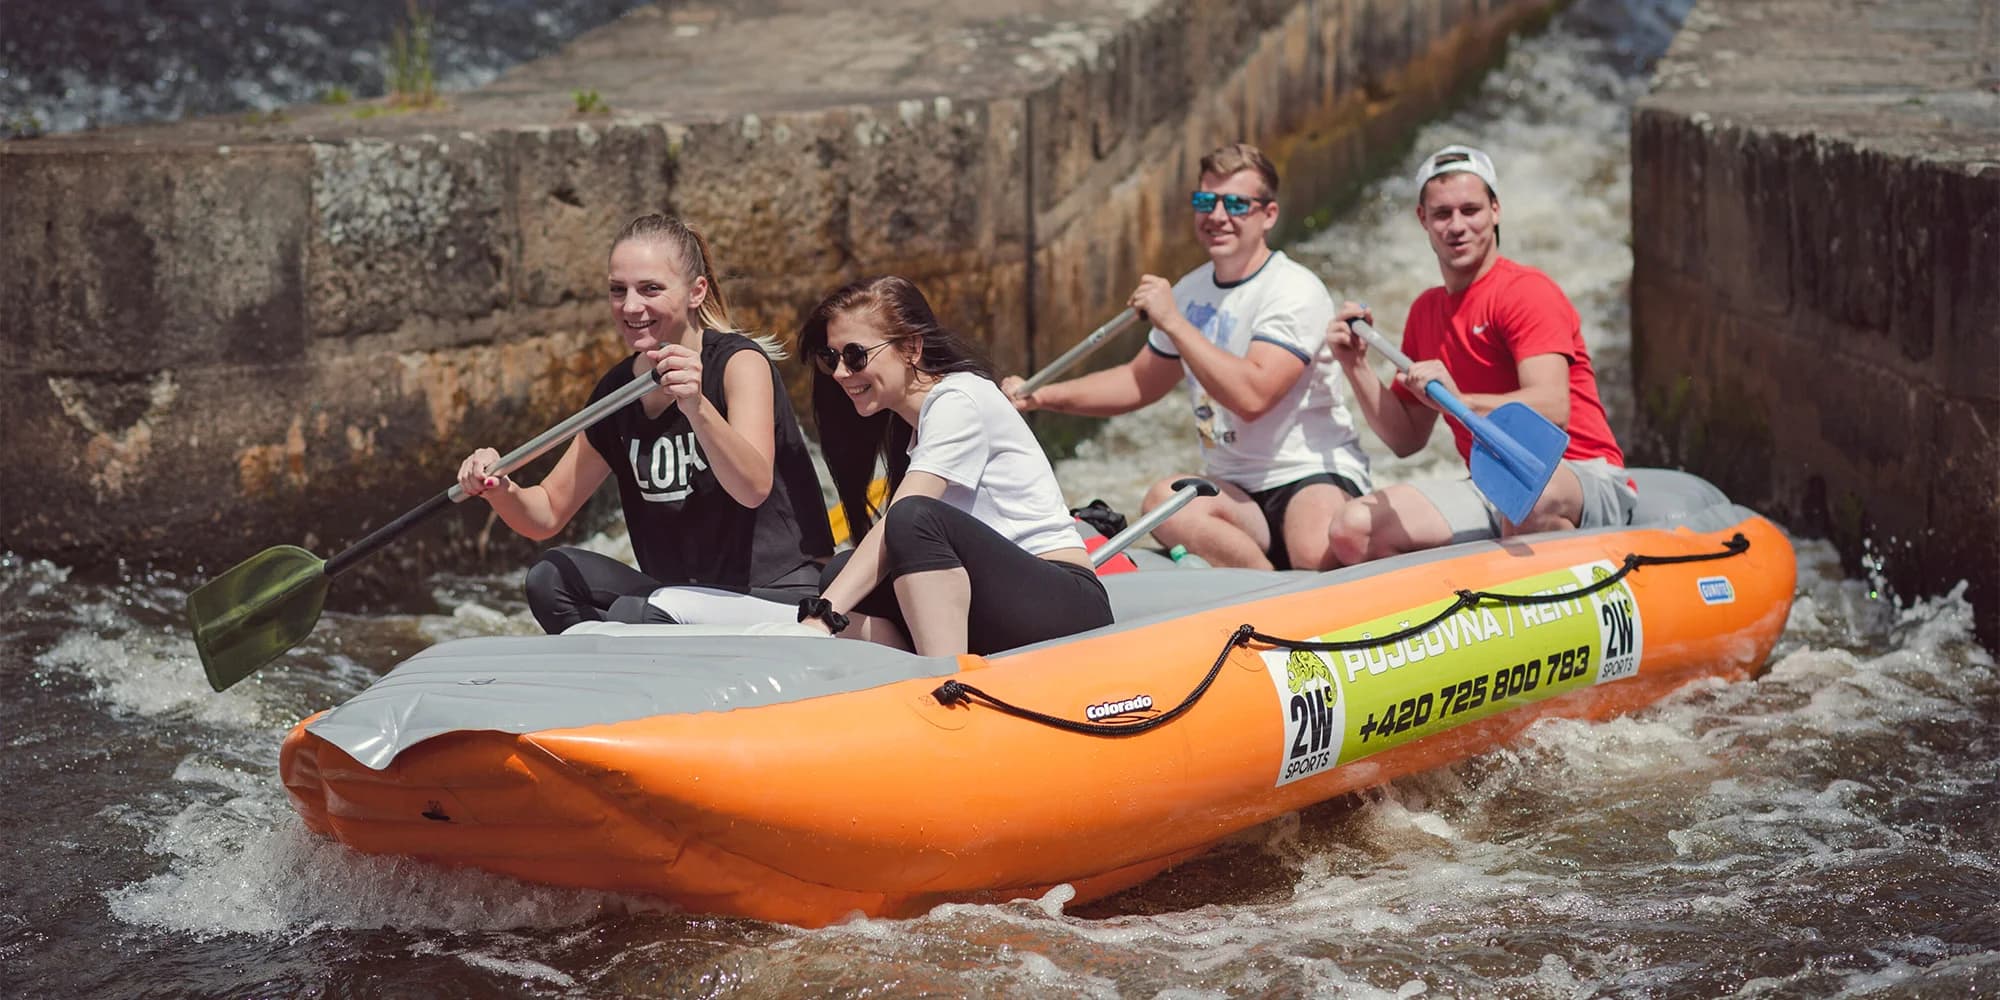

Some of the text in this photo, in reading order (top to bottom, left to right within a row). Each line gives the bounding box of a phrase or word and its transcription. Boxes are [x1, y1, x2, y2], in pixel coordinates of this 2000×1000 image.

[1519, 583, 1584, 628] RENT
[1602, 657, 1633, 678] SPORTS
[1086, 695, 1152, 719] Colorado
[1359, 645, 1590, 743] +420 725 800 783
[1285, 751, 1330, 779] SPORTS
